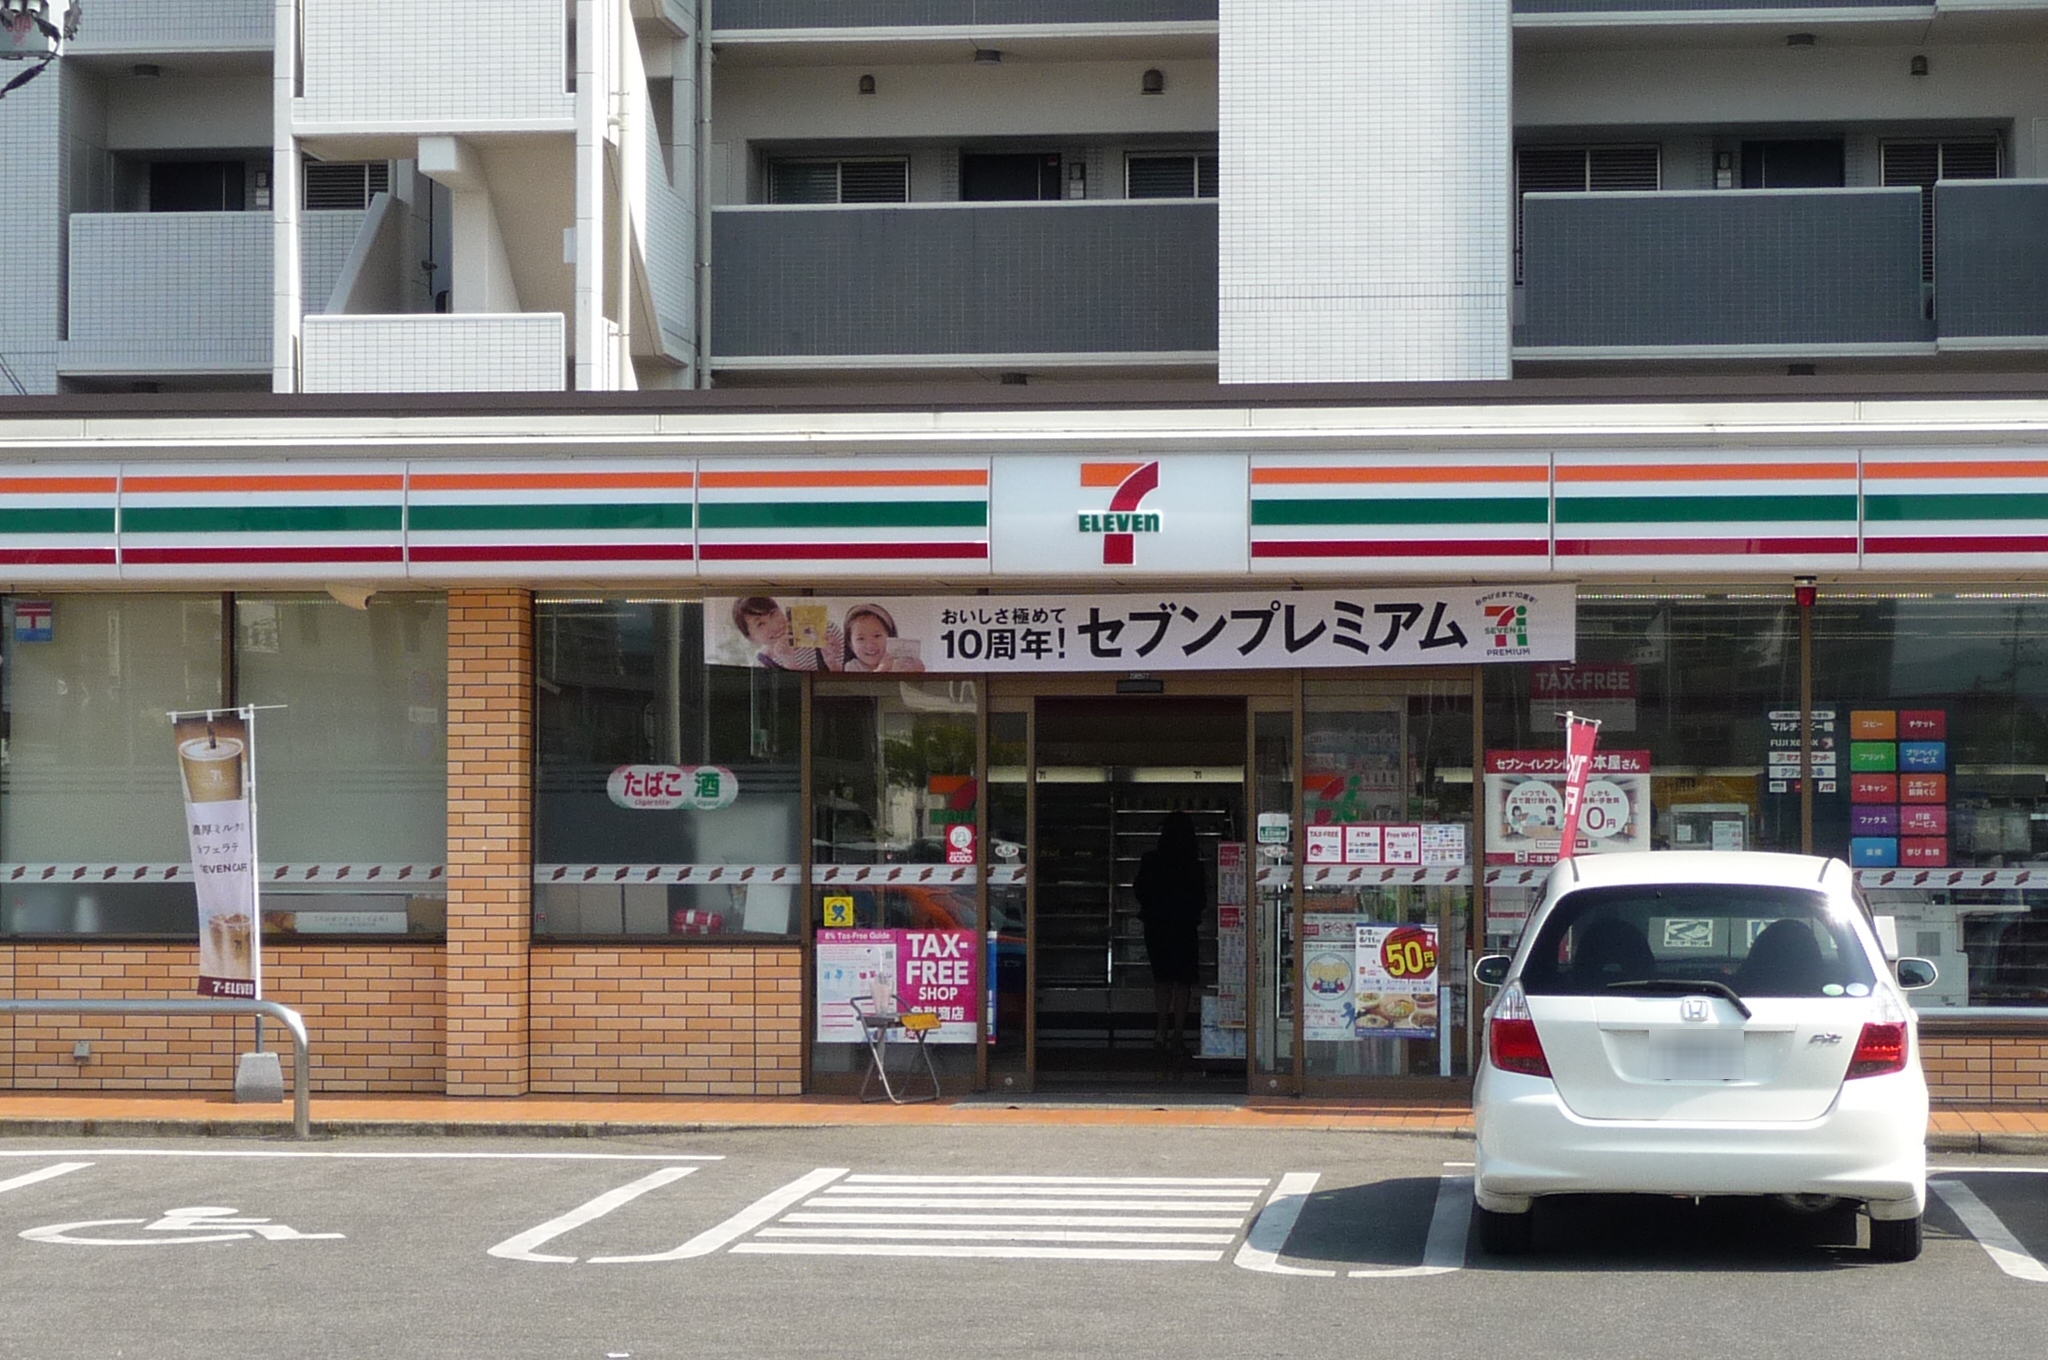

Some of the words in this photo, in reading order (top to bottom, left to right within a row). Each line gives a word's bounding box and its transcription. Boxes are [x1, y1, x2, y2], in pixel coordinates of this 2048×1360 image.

[941, 608, 1066, 625] おいしさ極めて
[1078, 600, 1468, 658] セブンプレミアム
[941, 628, 1066, 660] 10周年!
[1487, 648, 1531, 656] PREMIUM
[1535, 671, 1631, 691] TAX-FREE
[624, 771, 682, 797] たばこ
[694, 772, 720, 797] 酒
[869, 931, 890, 939] Guide
[907, 934, 968, 958] TAX-
[907, 961, 969, 985] FREE
[919, 987, 958, 1000] SHOP
